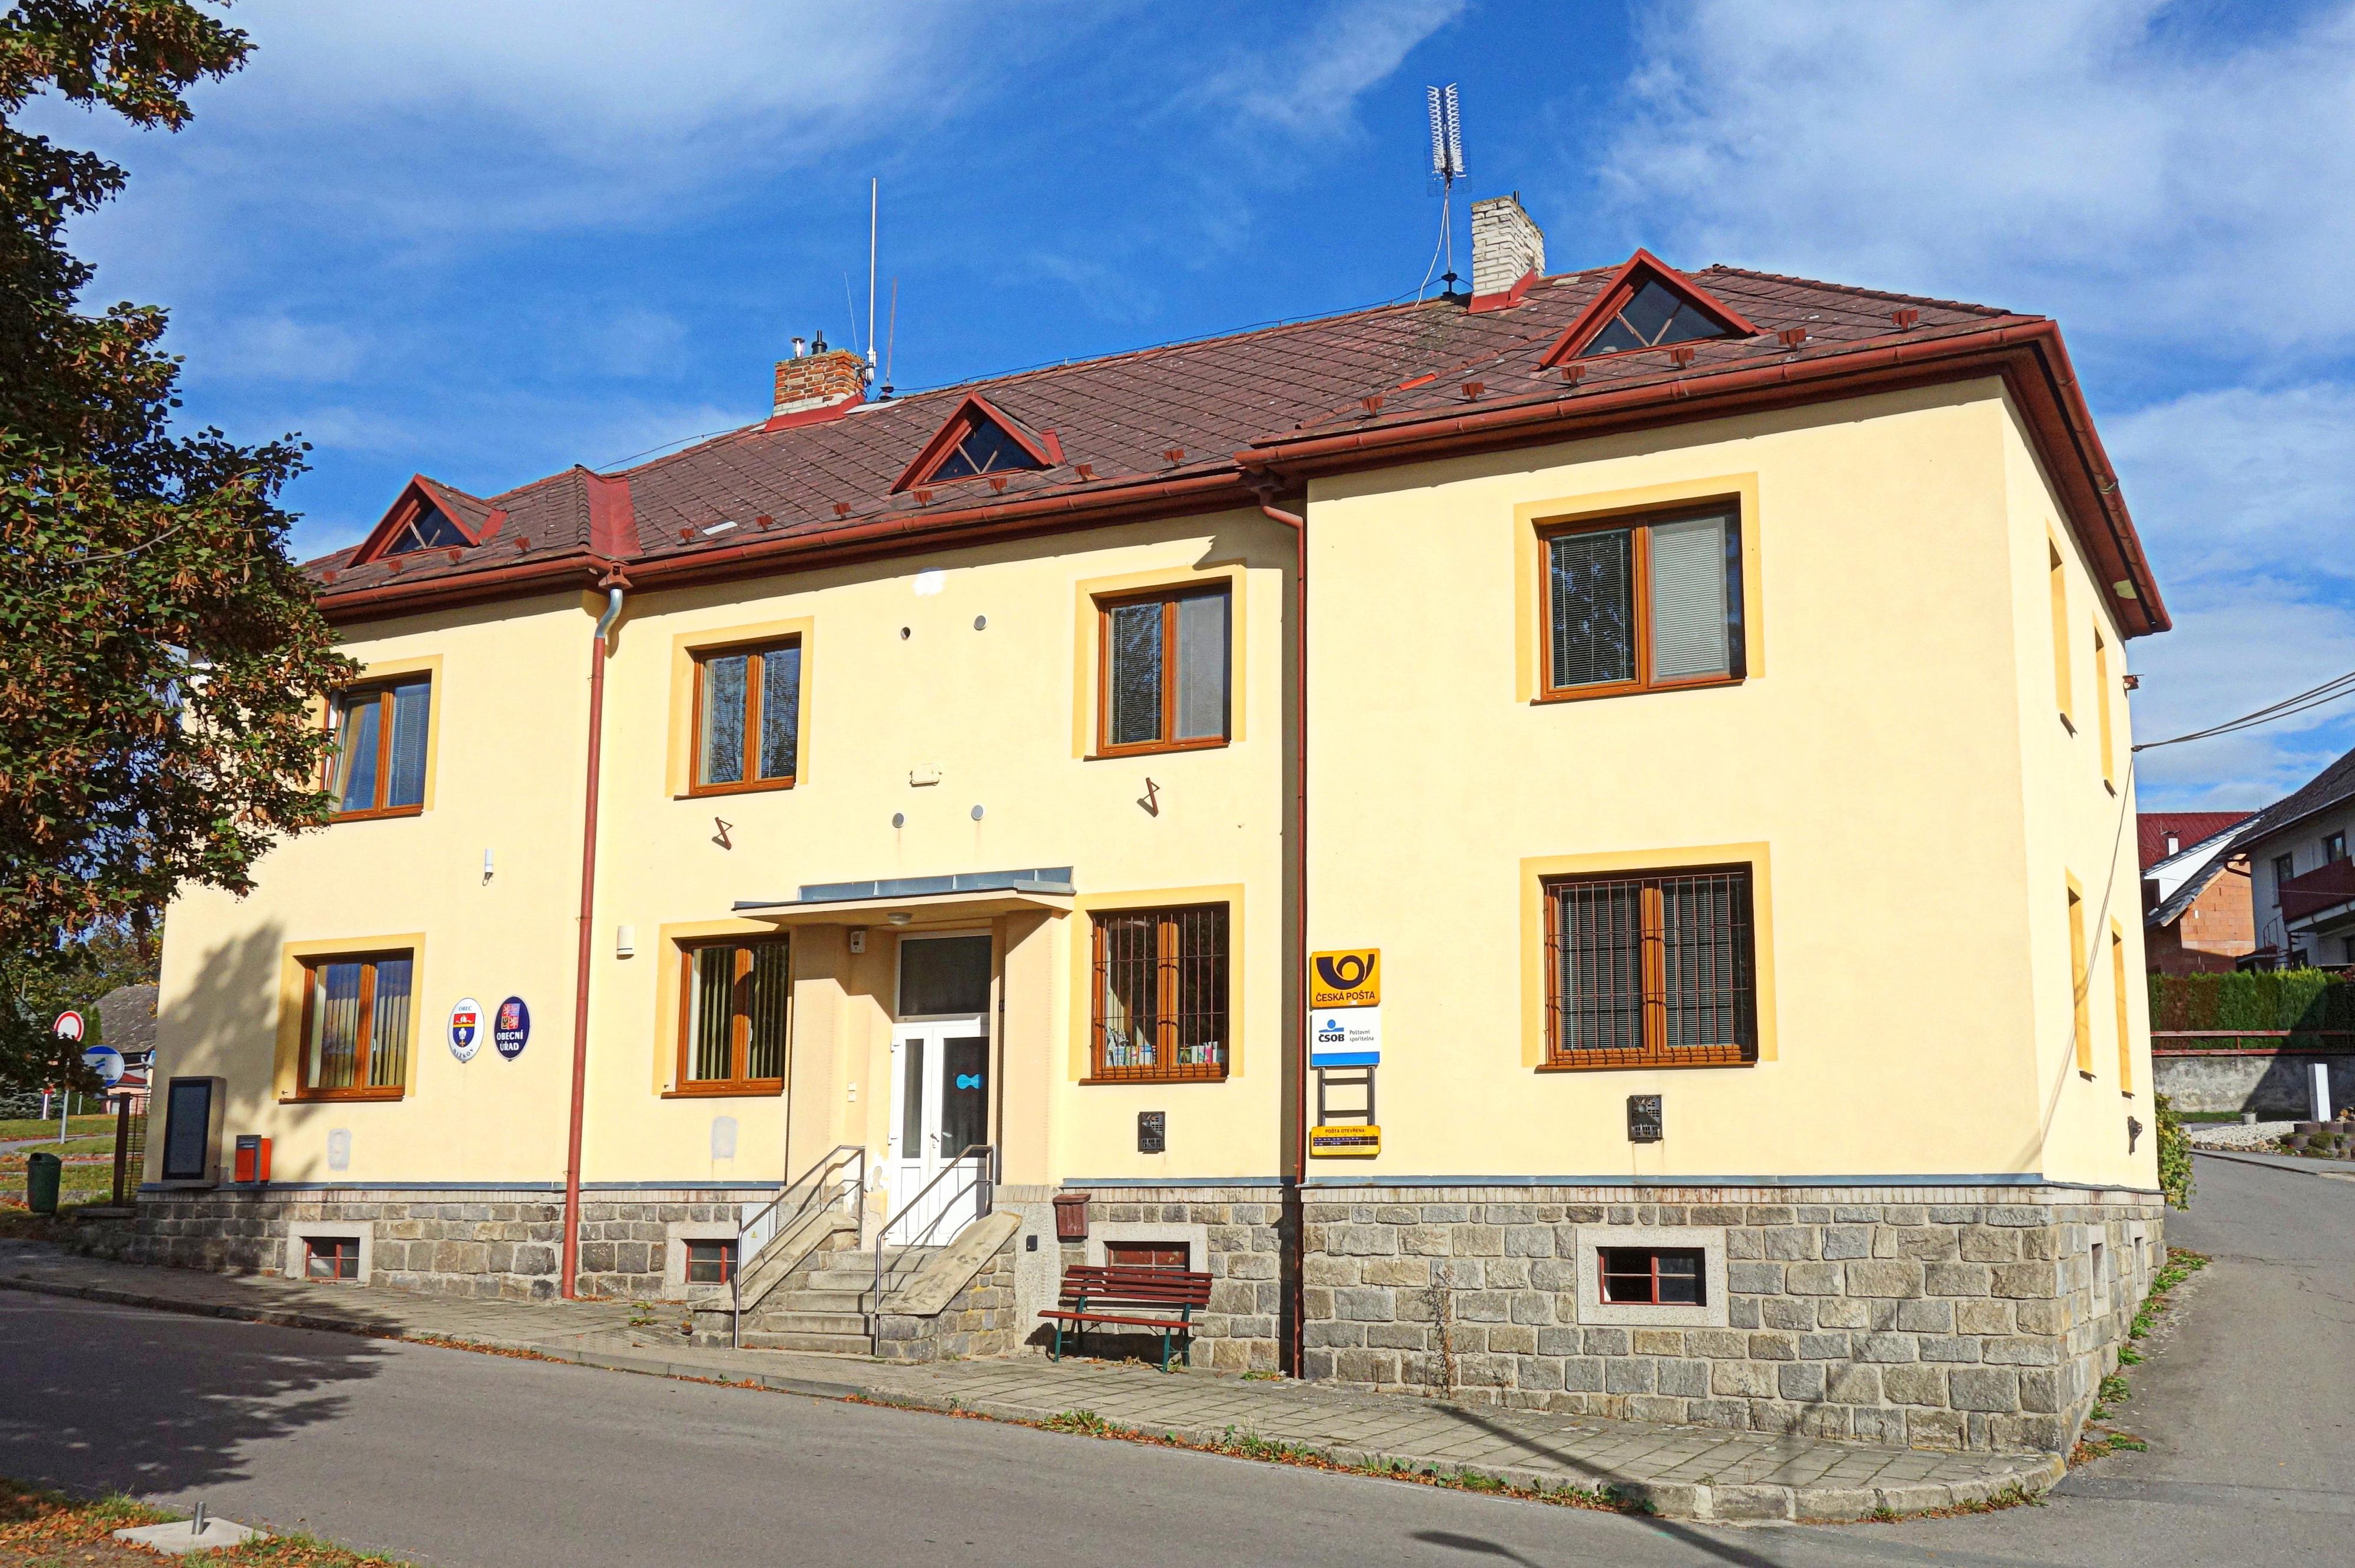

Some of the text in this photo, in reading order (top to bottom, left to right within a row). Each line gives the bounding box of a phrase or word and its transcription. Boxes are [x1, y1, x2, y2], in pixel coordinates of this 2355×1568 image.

[1316, 990, 1375, 1002] ČESKÁ POŠTA
[496, 1030, 523, 1040] OBECNÍ
[1319, 1034, 1345, 1042] ČSOB
[500, 1041, 519, 1051] ÚŘAD
